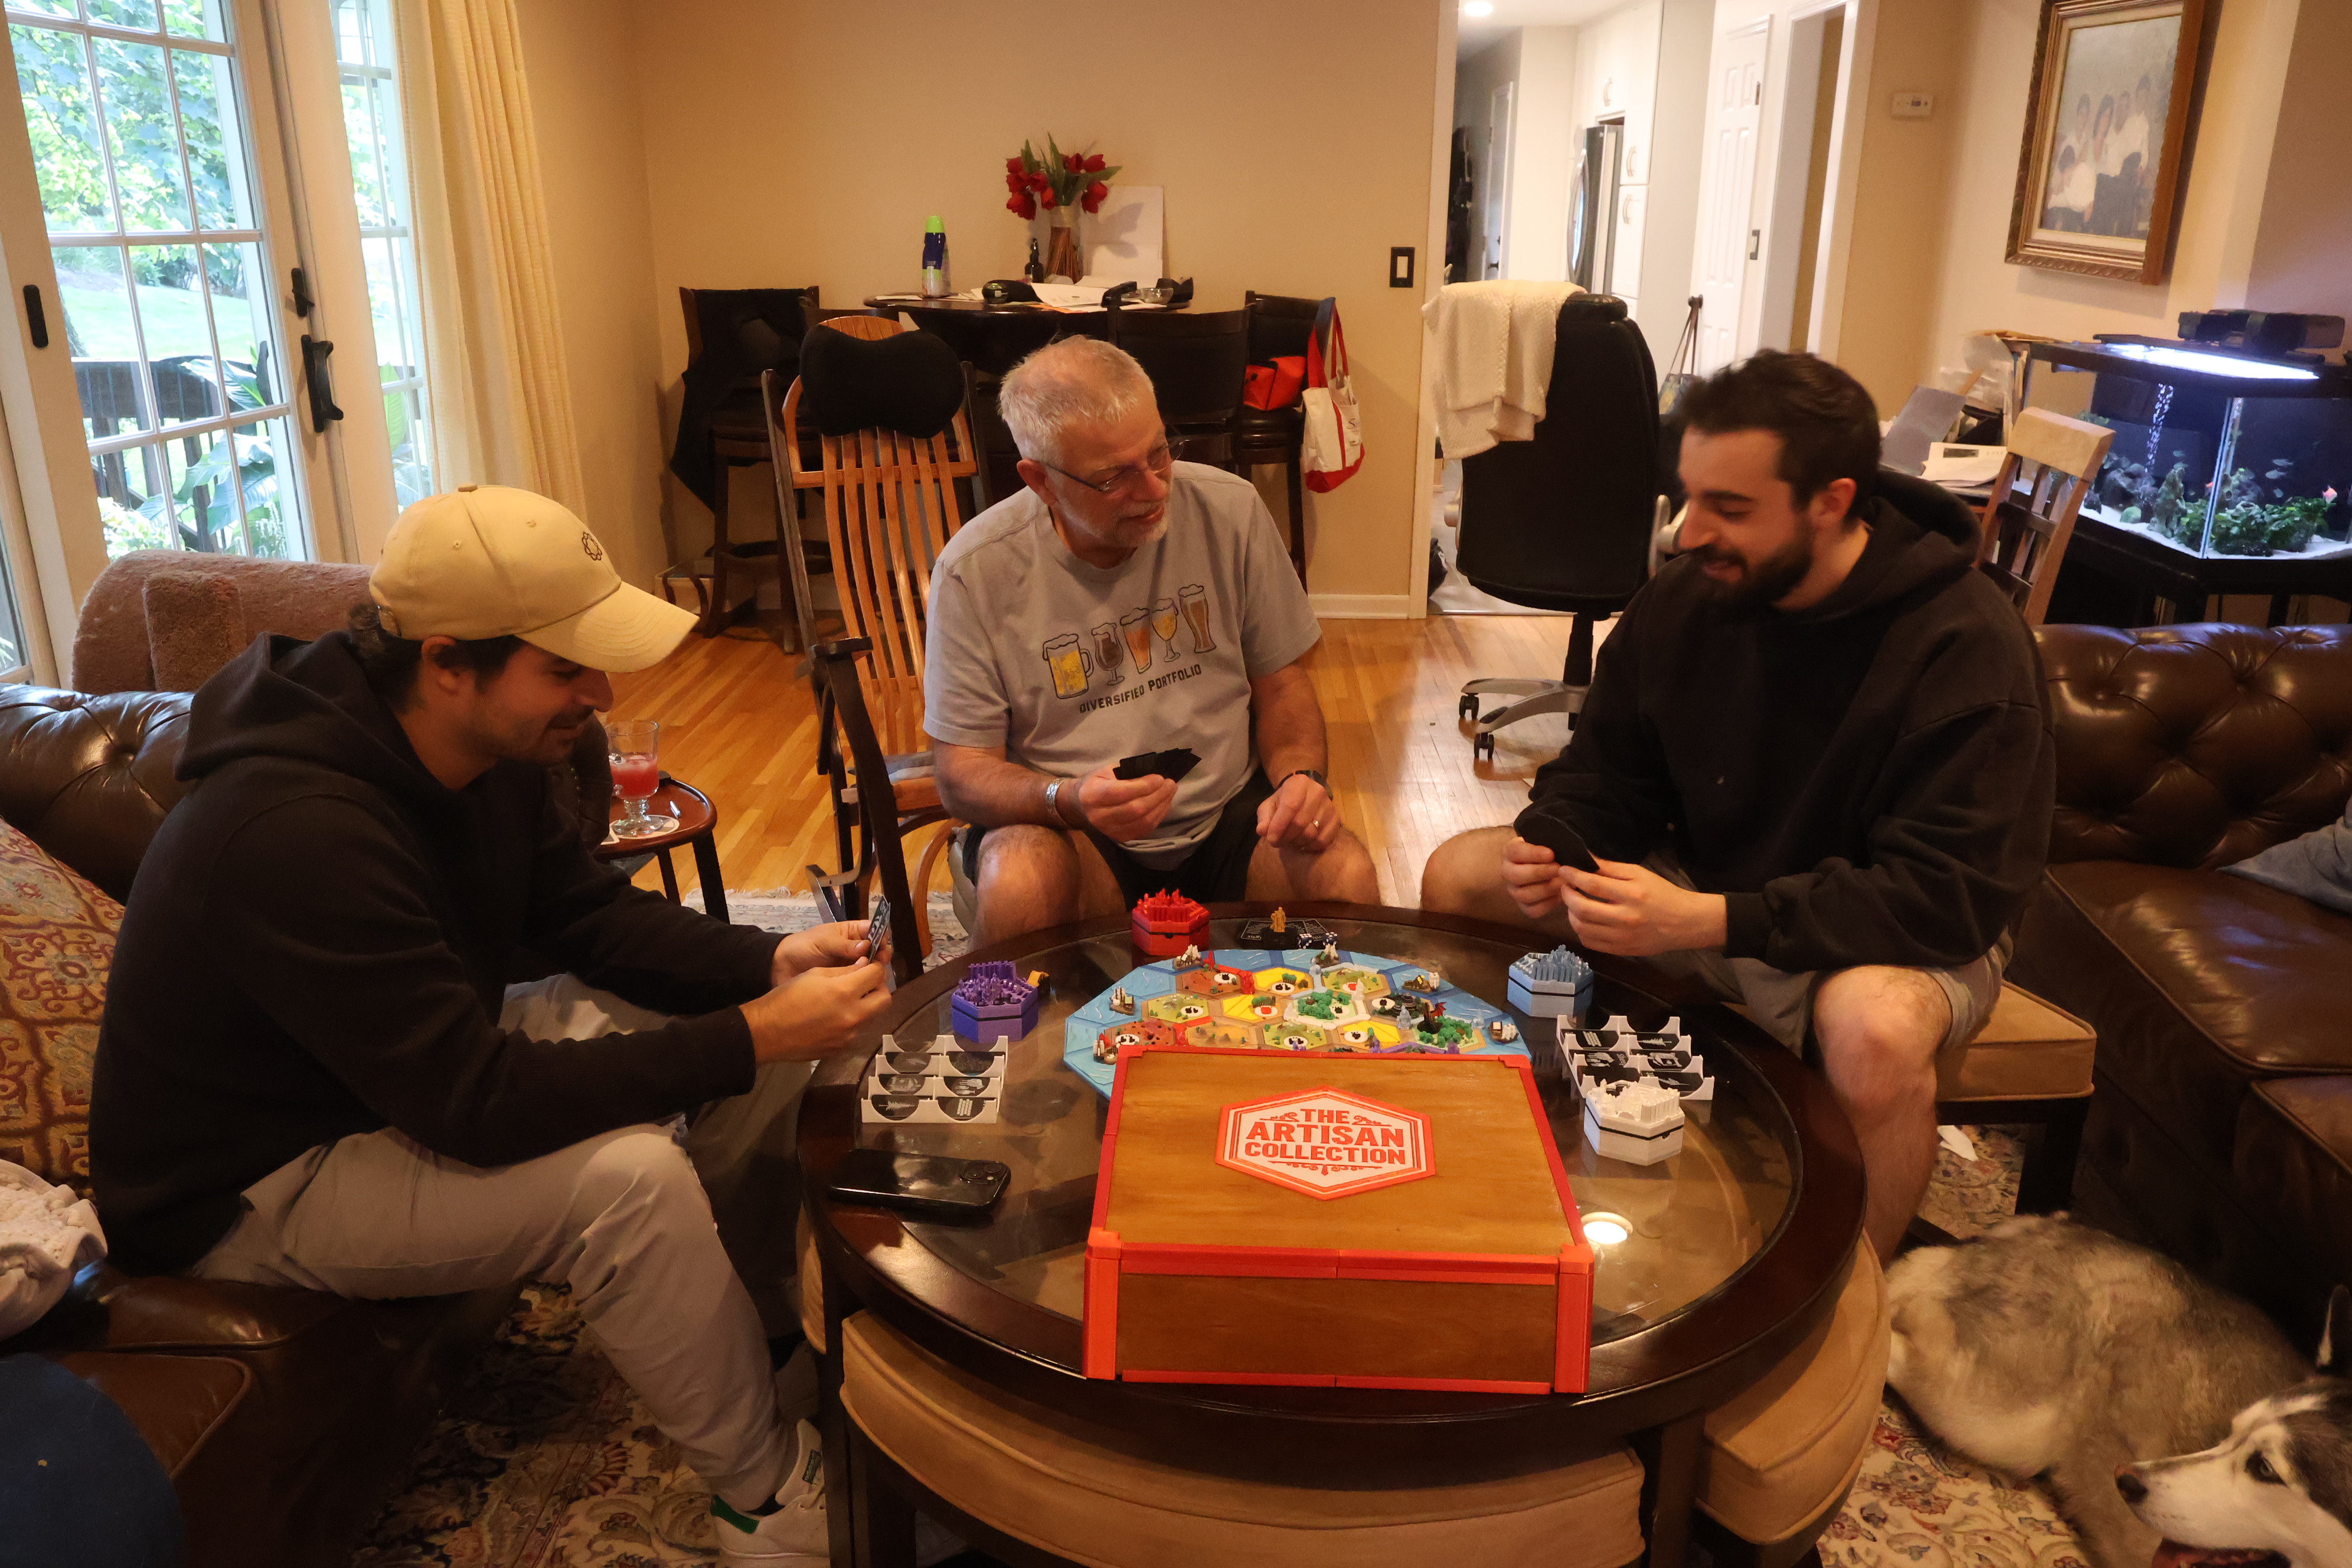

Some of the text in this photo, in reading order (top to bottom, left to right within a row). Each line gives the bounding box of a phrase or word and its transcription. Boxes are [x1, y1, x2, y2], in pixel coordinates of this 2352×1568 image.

[1079, 664, 1202, 714] DIVERSIFIED PORTFOLIO
[1300, 1108, 1350, 1125] THE
[1246, 1121, 1404, 1148] ARTISAN
[1244, 1141, 1406, 1165] COLLECTION
